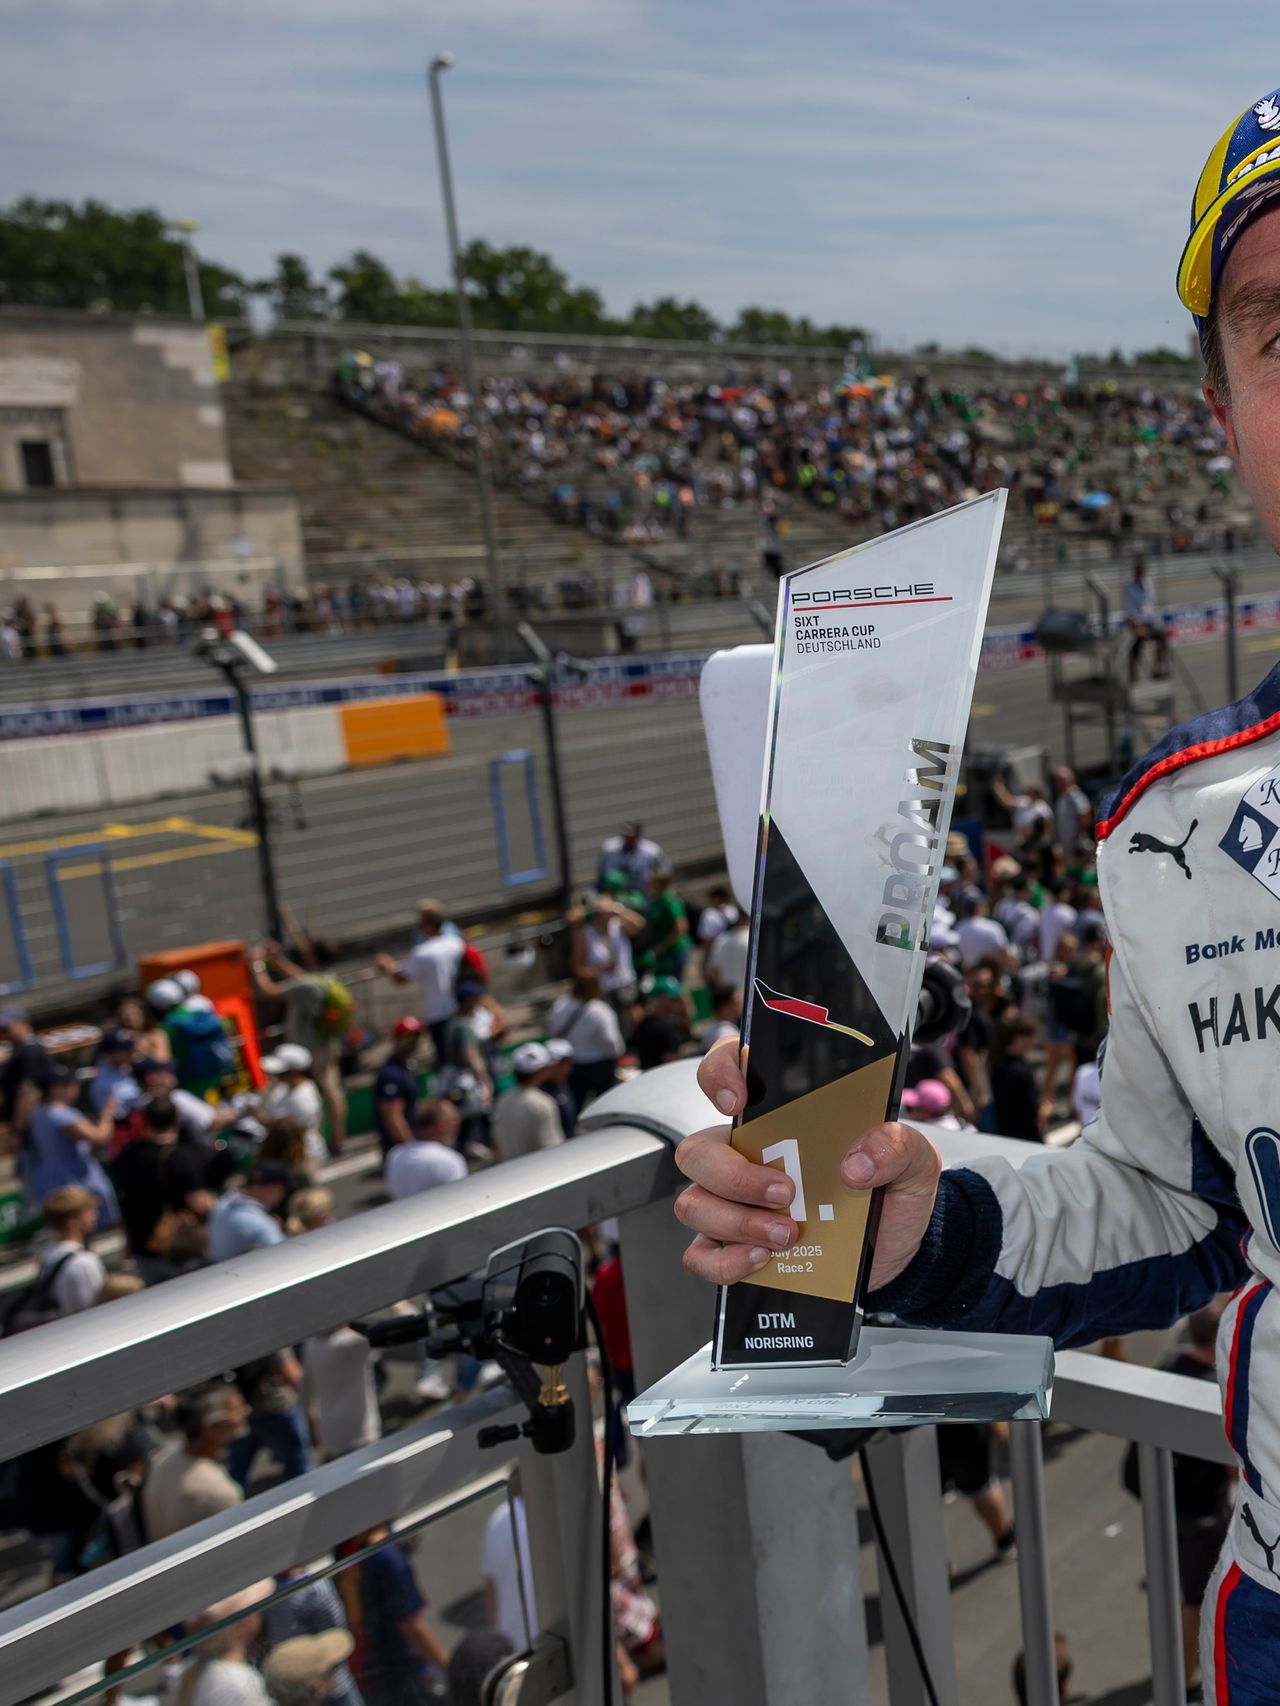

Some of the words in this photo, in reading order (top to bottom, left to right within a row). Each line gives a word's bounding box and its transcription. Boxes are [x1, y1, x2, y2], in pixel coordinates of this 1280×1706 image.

[791, 583, 934, 605] PORSCHE
[794, 615, 820, 628] SIXT
[795, 626, 850, 641] CARRERA
[851, 624, 875, 637] CUP
[796, 637, 881, 654] DEUTSCHLAND
[762, 1138, 835, 1222] 1.
[792, 1245, 823, 1258] 2025
[777, 1262, 804, 1274] Race
[805, 1261, 814, 1273] 2
[757, 1312, 796, 1330] DTM
[744, 1335, 815, 1350] NORISRING
